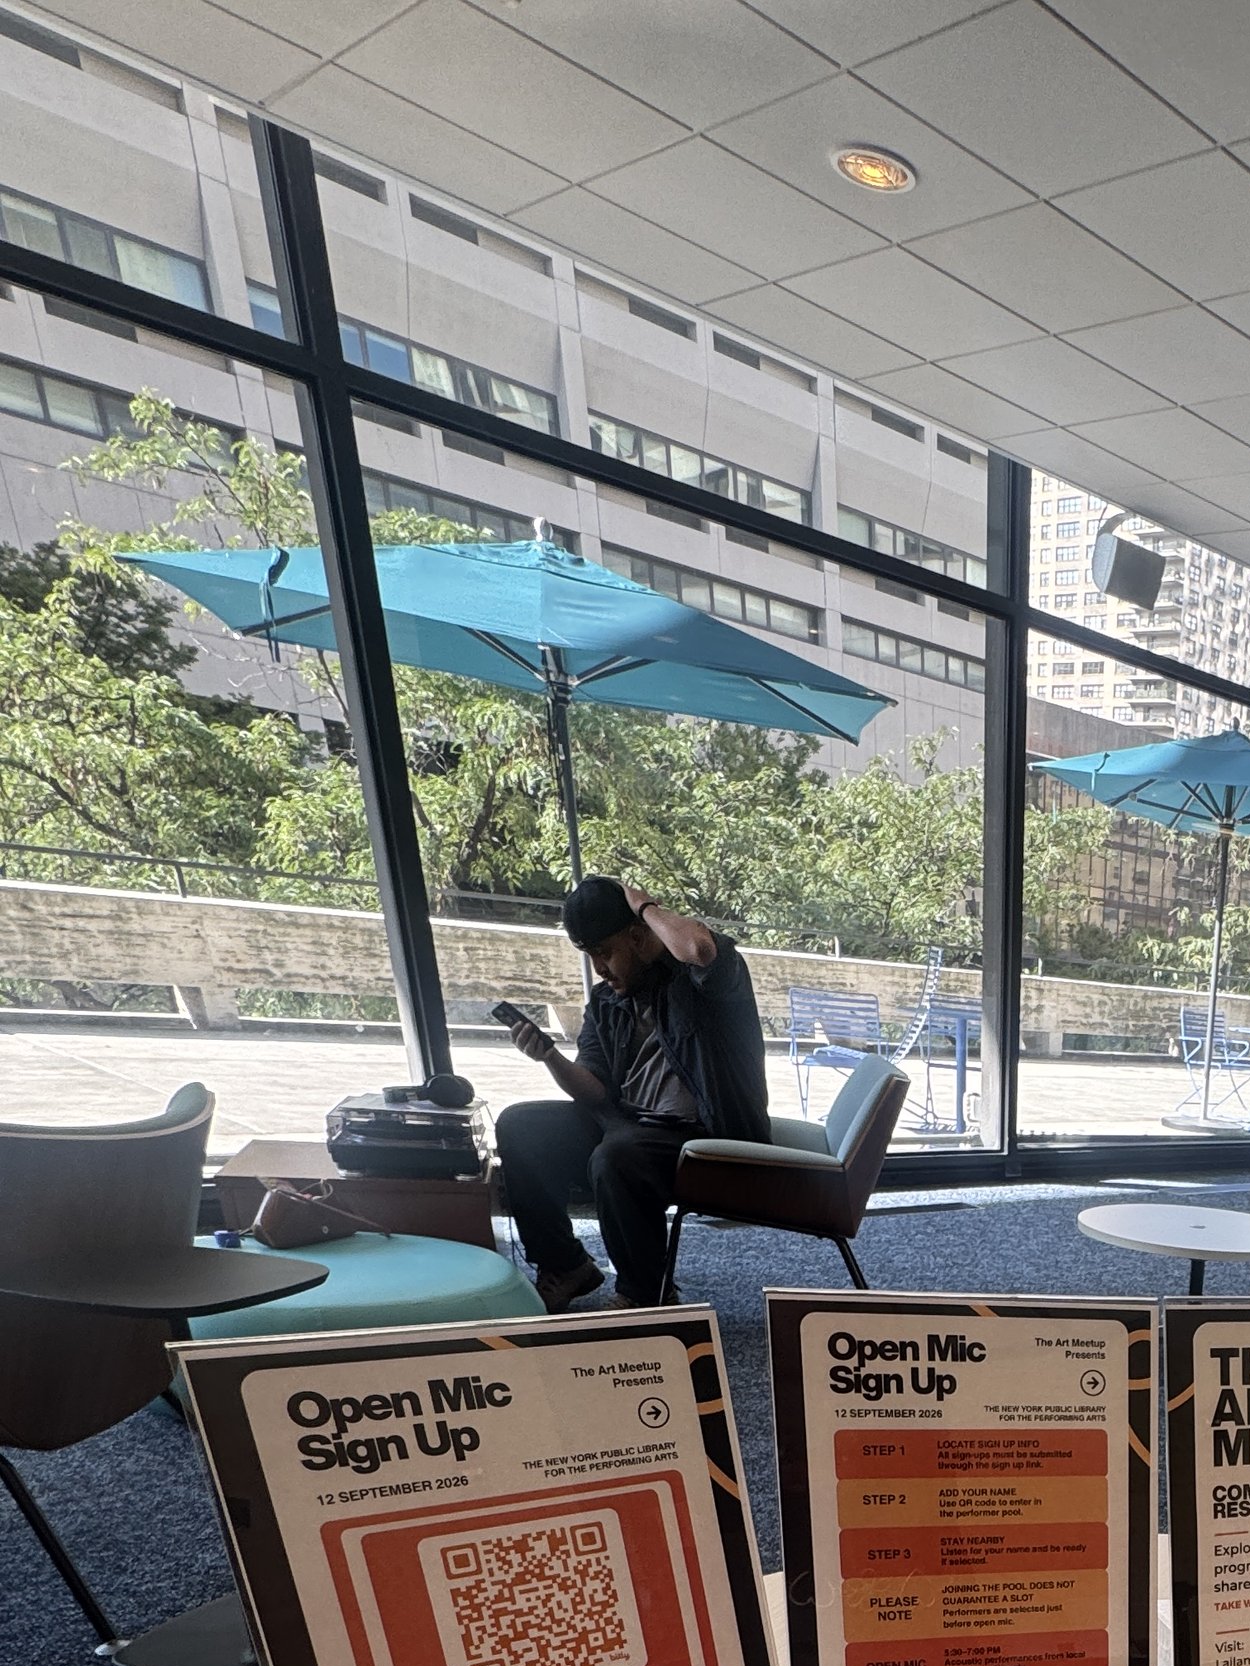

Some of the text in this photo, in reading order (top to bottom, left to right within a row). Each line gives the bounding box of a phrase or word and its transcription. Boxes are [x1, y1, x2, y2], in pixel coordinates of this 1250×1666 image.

[827, 1331, 987, 1371] Open Mic
[1065, 1350, 1106, 1360] Presents
[570, 1361, 662, 1378] The Art Meetup
[612, 1374, 665, 1389] Presents
[829, 1365, 957, 1402] Sign Up
[286, 1375, 513, 1438] Open Mic
[834, 1408, 943, 1419] 12 SEPTEMBER 2026
[297, 1420, 481, 1475] Sign Up
[862, 1444, 905, 1456] STEP 1
[937, 1439, 1040, 1450] LOCATE SIGN UP INFO
[521, 1441, 676, 1470] THE NEW YORK PUBLIC LIBRARY
[543, 1451, 679, 1478] FOR THE PERFORMING ARTS
[316, 1475, 469, 1506] 12 SEPTEMBER 2026
[938, 1487, 1017, 1498] ADD YOUR NAME
[862, 1494, 906, 1506] STEP 2
[940, 1535, 1005, 1546] STAY NEARBY
[867, 1548, 912, 1561] STEP 3
[869, 1596, 920, 1608] PLEASE
[1213, 1599, 1242, 1612] TAKE
[877, 1609, 913, 1622] NOTE
[1214, 1640, 1245, 1654] Visit:
